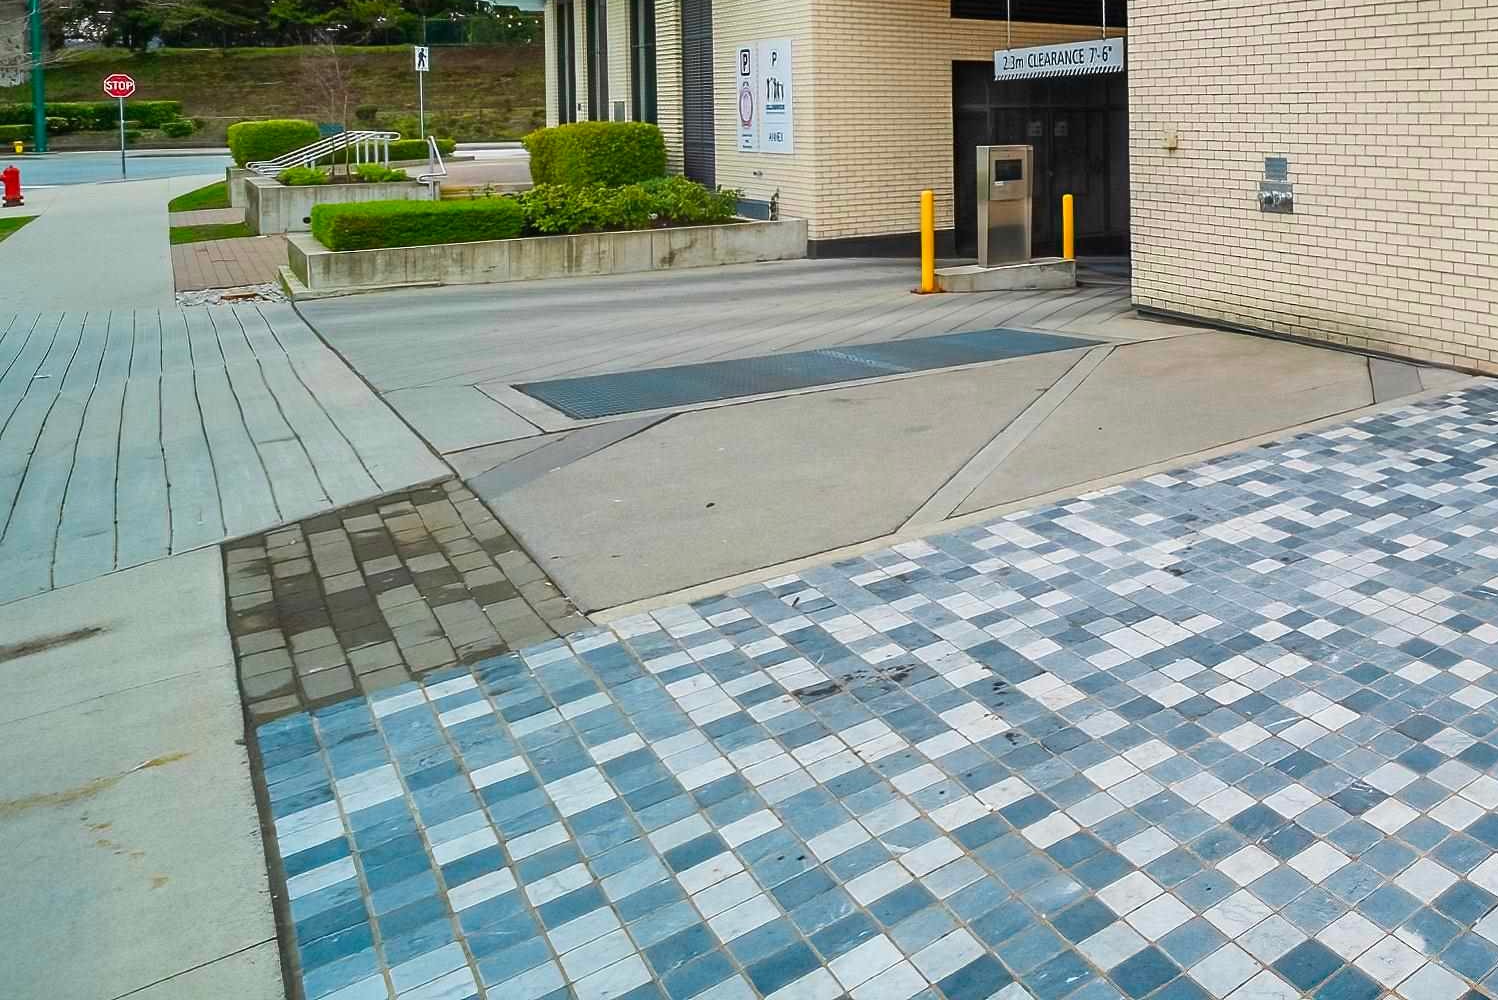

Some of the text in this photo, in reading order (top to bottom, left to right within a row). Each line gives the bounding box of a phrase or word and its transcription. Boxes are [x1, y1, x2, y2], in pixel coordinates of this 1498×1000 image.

[742, 53, 748, 72] P
[771, 51, 777, 67] P
[1028, 48, 1085, 68] CLEARANCE
[106, 80, 133, 90] STOP
